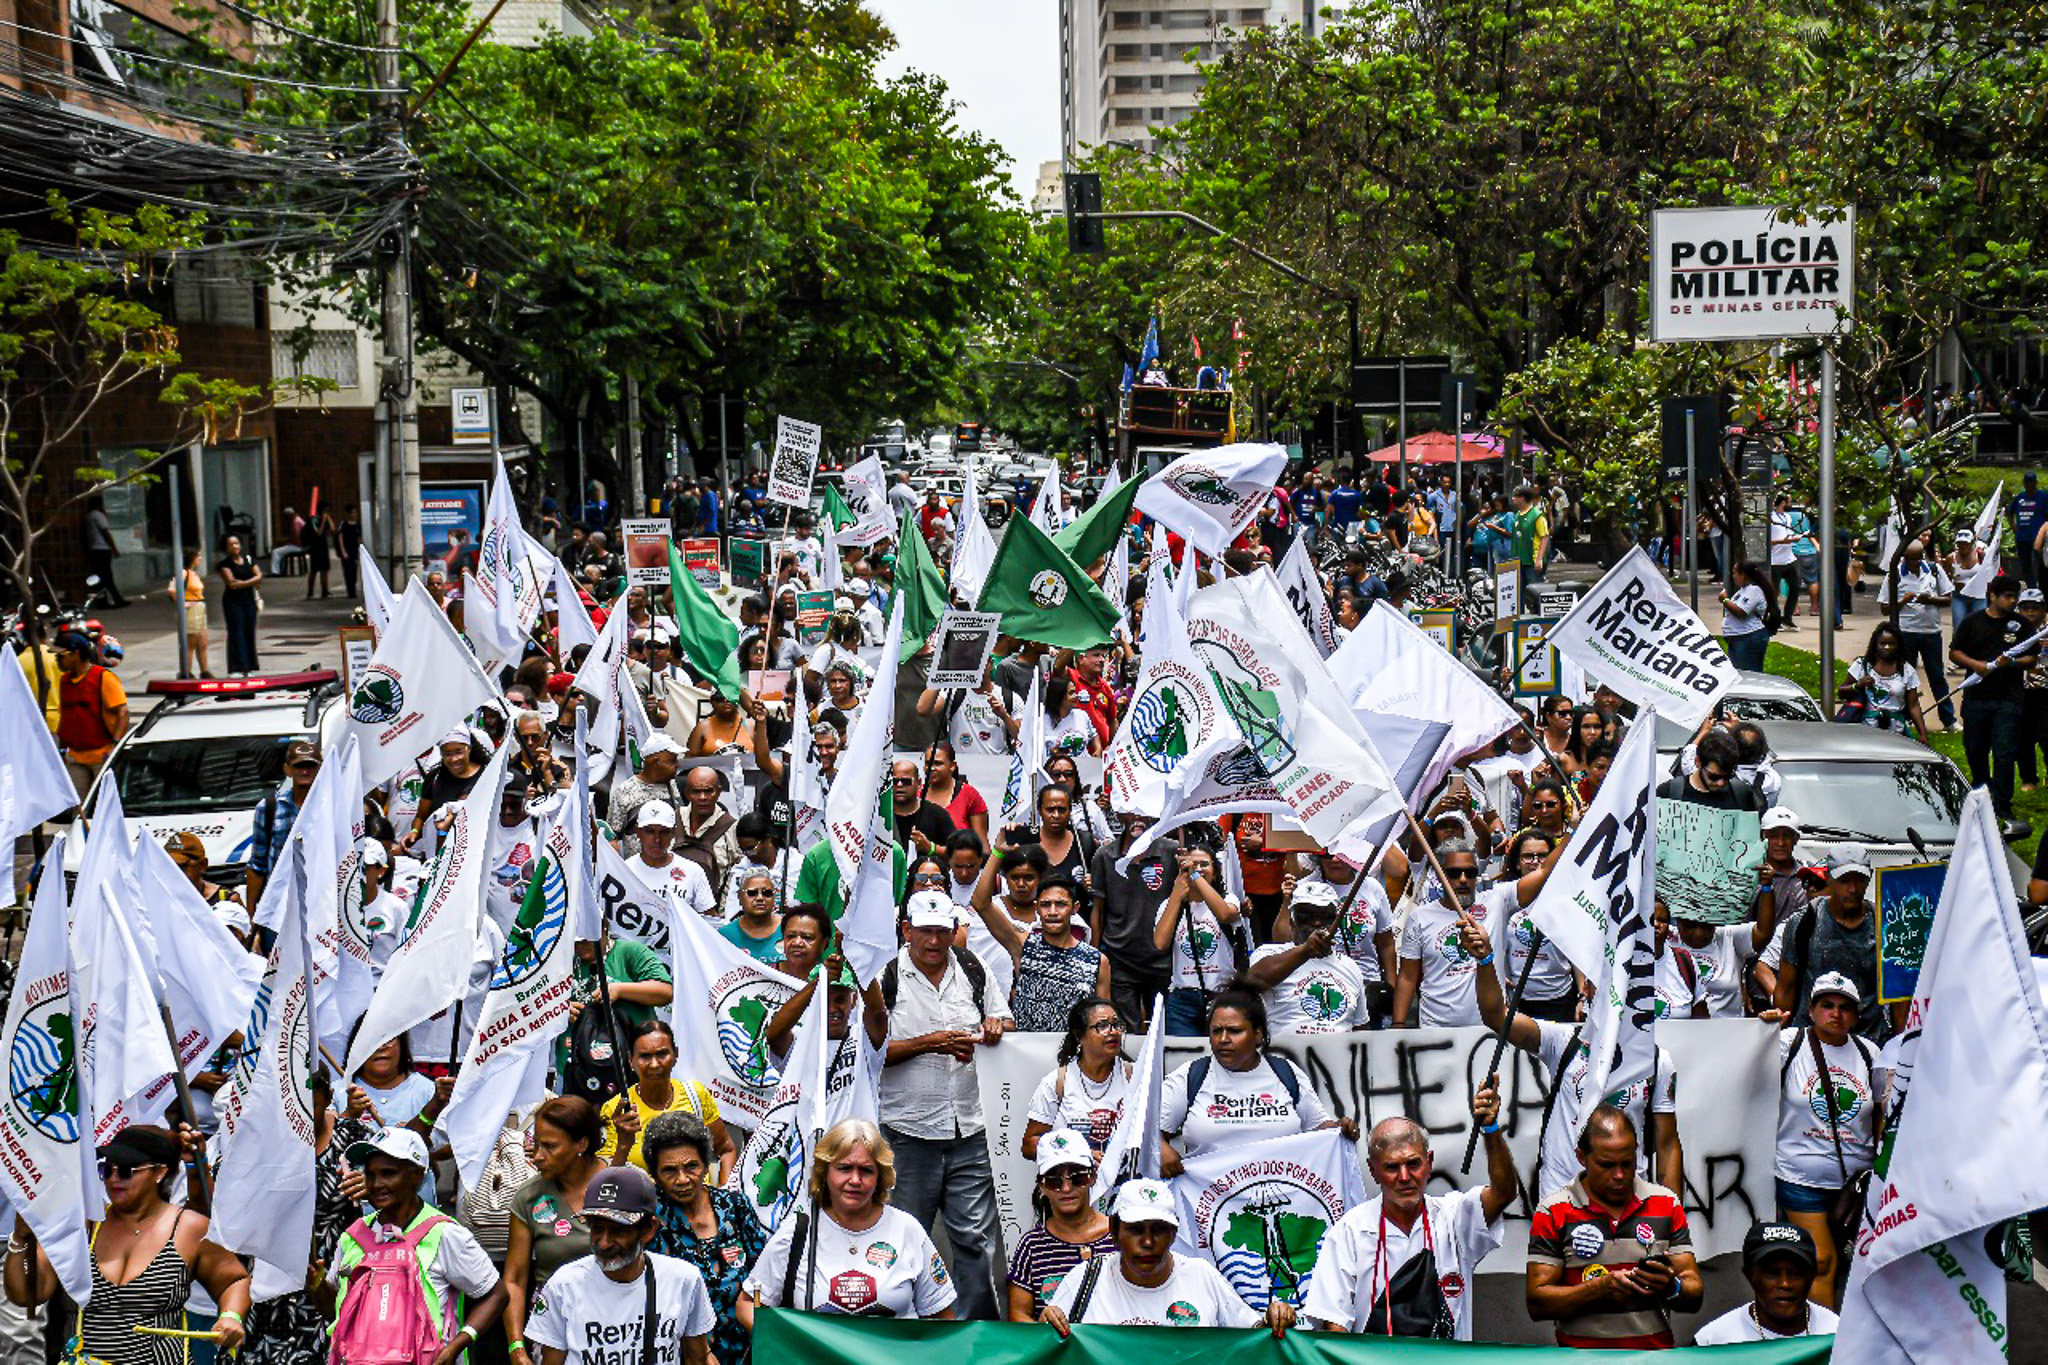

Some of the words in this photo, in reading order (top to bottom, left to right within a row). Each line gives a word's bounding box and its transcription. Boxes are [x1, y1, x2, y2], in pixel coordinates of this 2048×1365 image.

[1671, 231, 1839, 267] POLÍCIA
[1671, 268, 1839, 299] MILITAR
[1670, 305, 1692, 314] DE
[1703, 302, 1763, 313] MINAS
[1773, 299, 1839, 311] GERAIS
[1616, 576, 1727, 668] Revida
[1587, 597, 1719, 695] Mariana
[1295, 771, 1335, 801] ENER
[1299, 779, 1356, 823] MERCADO
[770, 810, 790, 821] Ma
[773, 801, 790, 812] Re
[25, 970, 68, 1006] MOVIME
[515, 973, 550, 1004] Brasil
[521, 1003, 533, 1018] E
[474, 1043, 499, 1068] NÃO
[500, 1027, 527, 1050] SÃO
[0, 1142, 38, 1202] ADORIAS
[1225, 1159, 1285, 1188] ATINGIDOS
[1285, 1161, 1309, 1185] POR
[1923, 1239, 1966, 1280] par
[1959, 1281, 2007, 1344] essa
